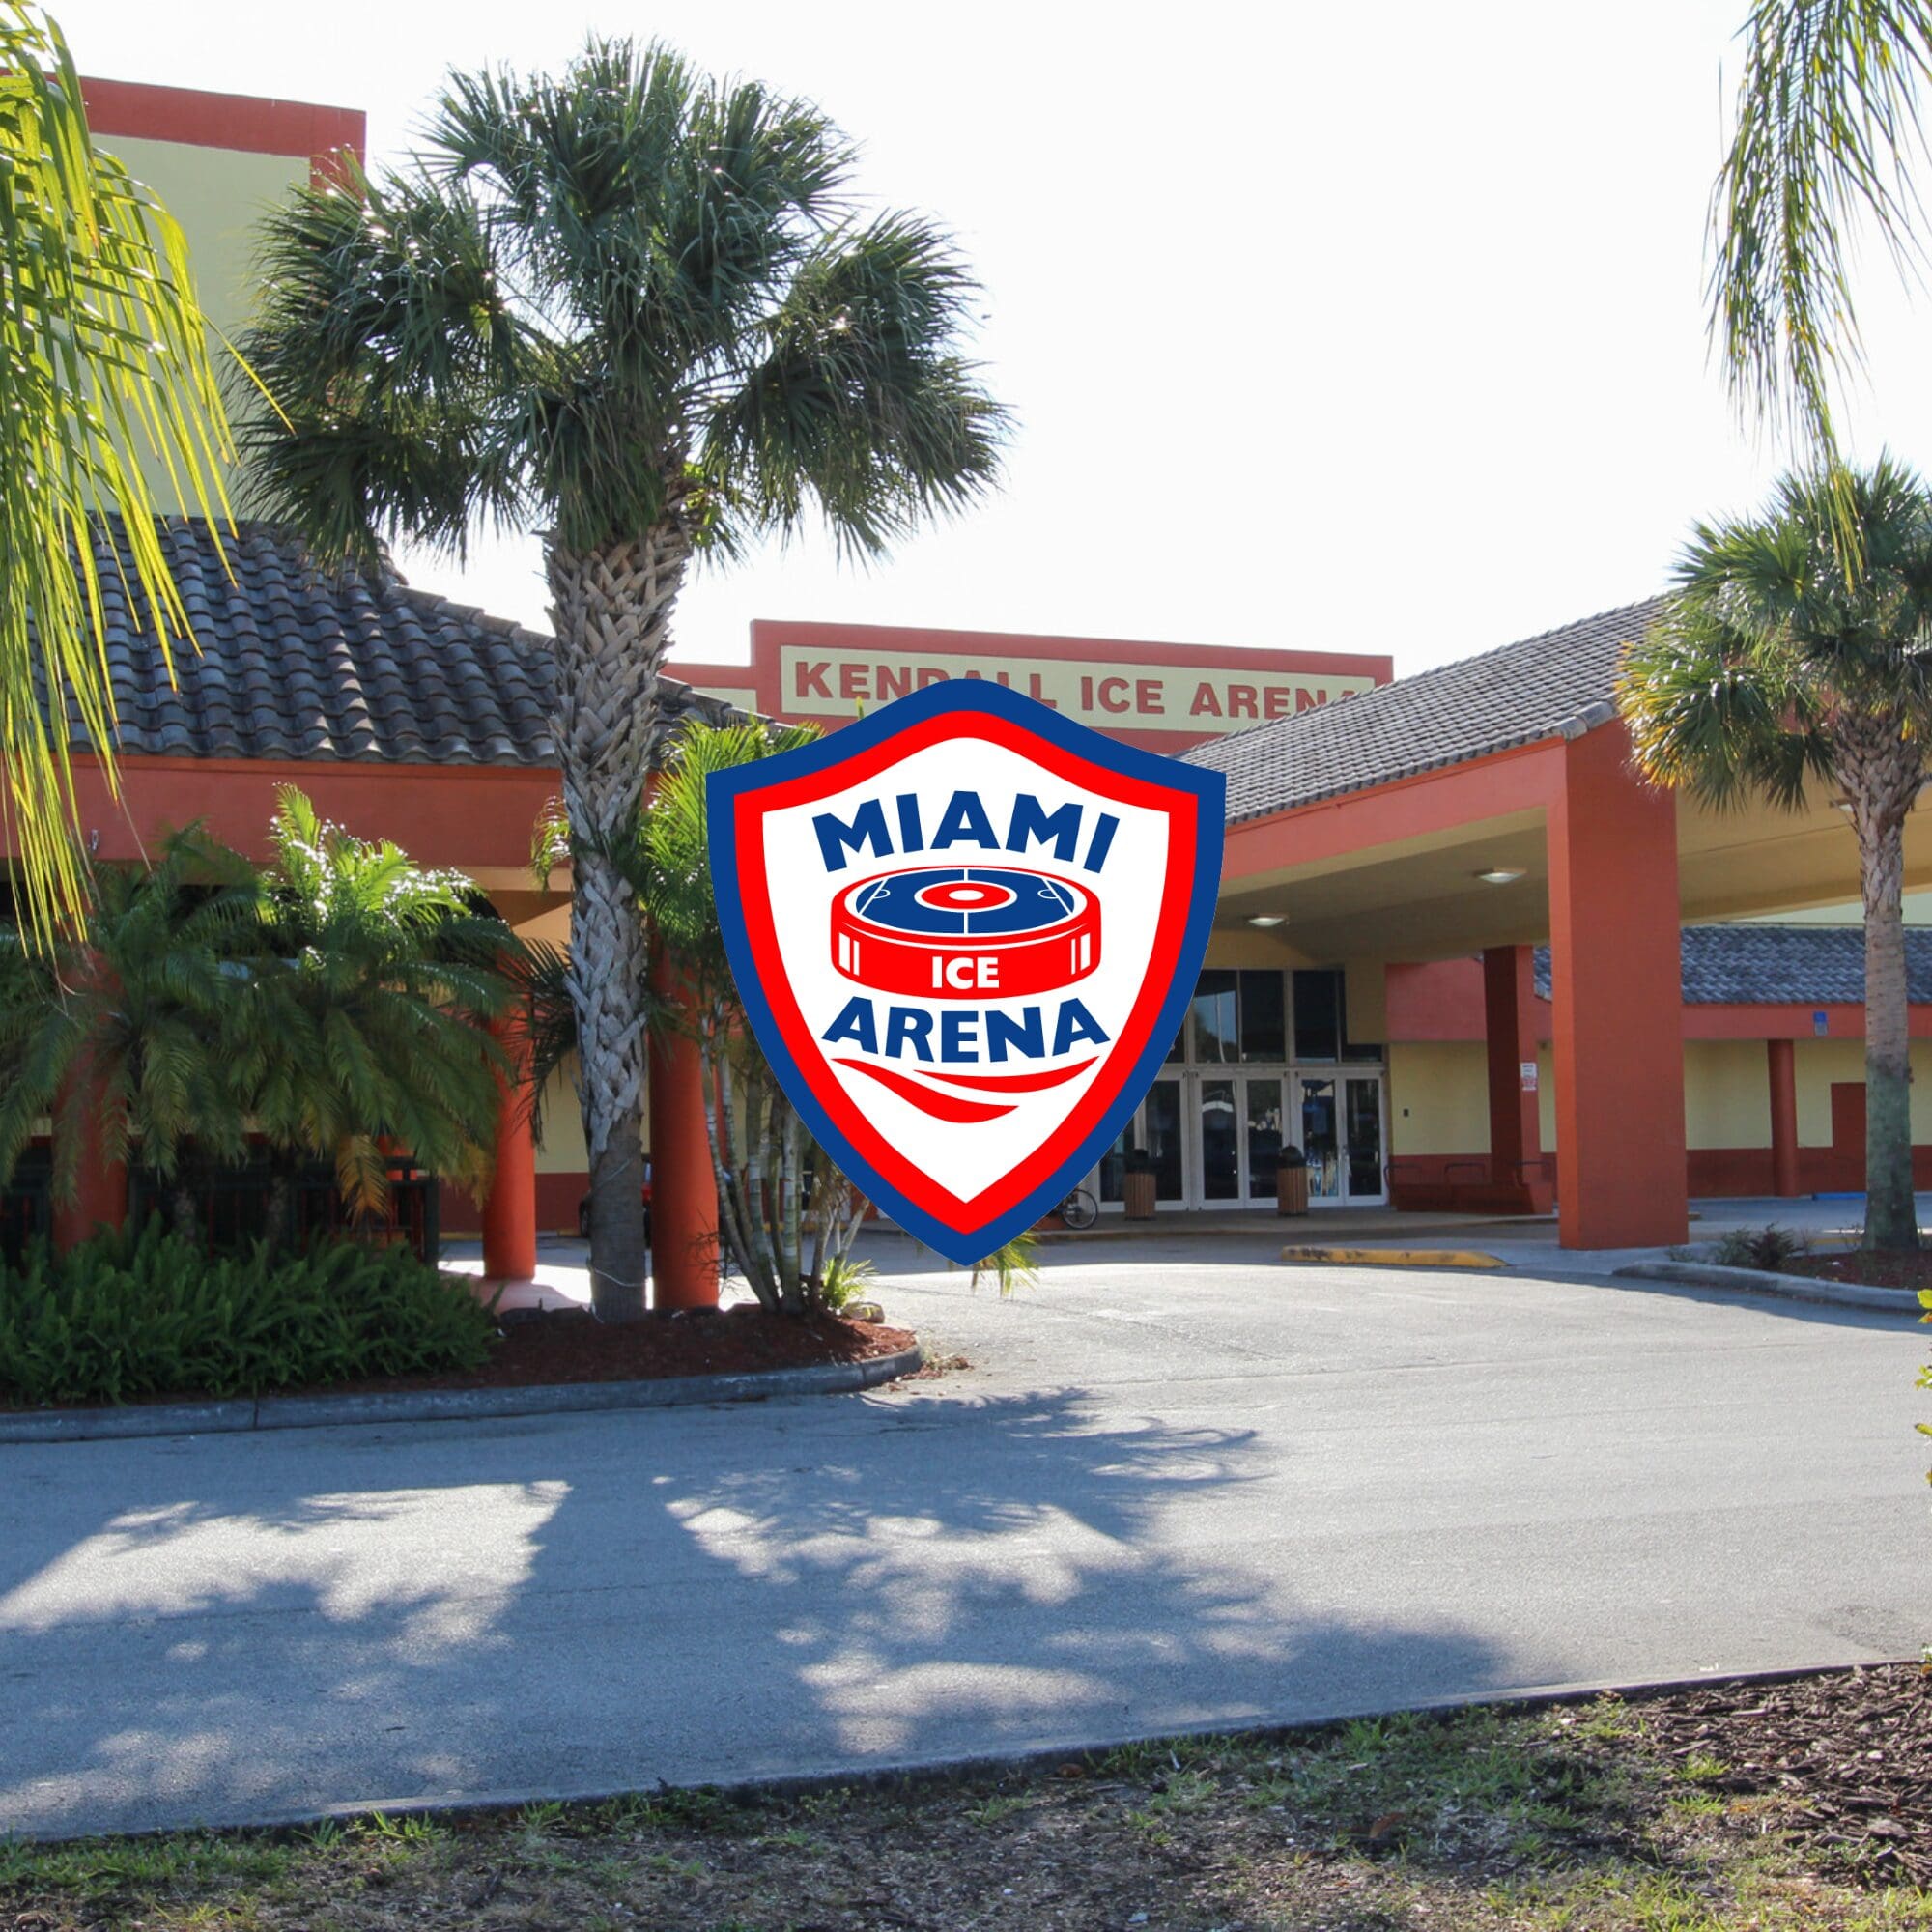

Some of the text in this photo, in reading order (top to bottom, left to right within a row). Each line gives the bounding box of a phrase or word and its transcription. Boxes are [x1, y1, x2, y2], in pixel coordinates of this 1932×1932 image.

[795, 661, 1356, 720] KENL ICE AREN
